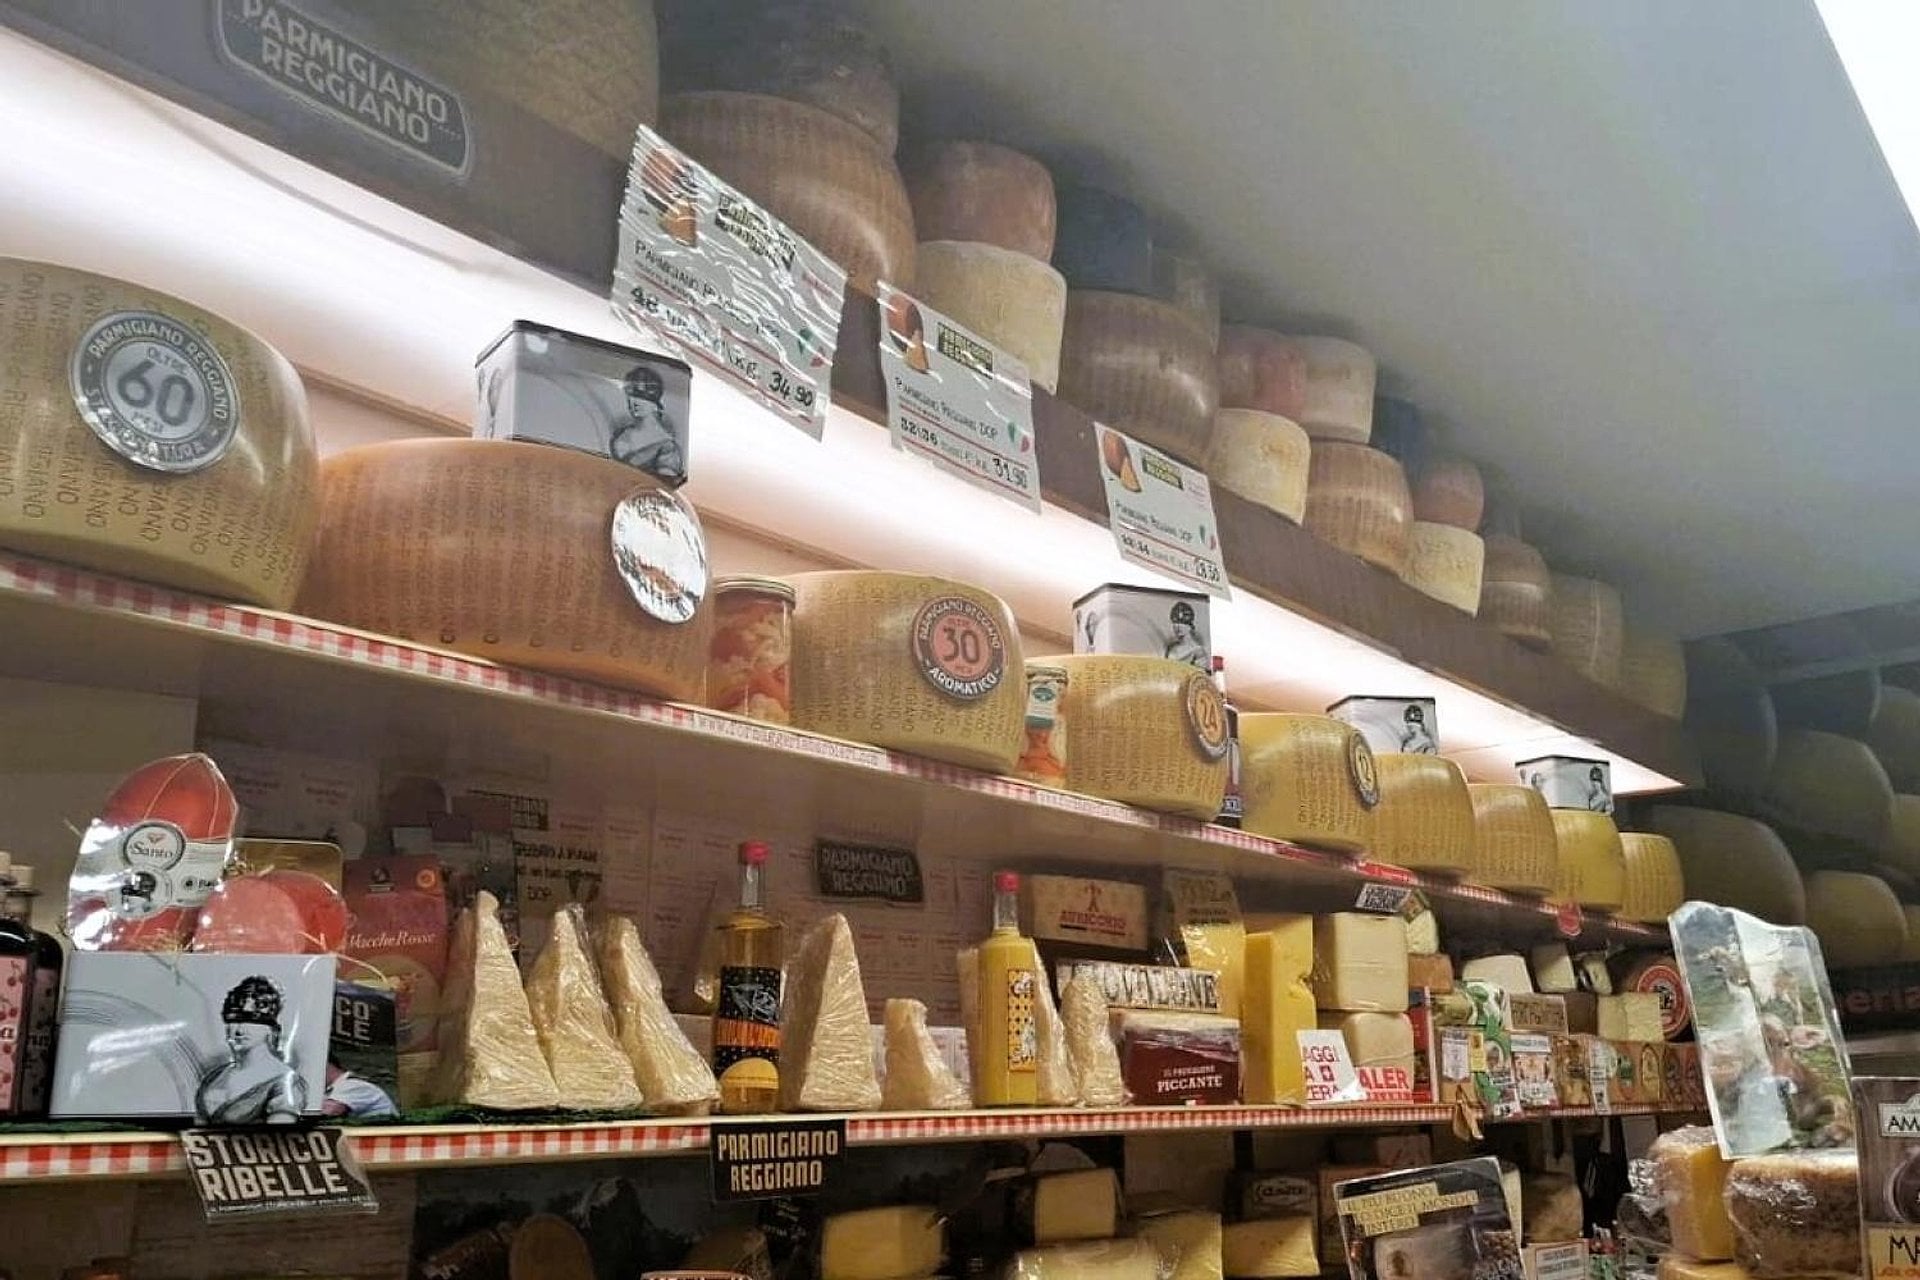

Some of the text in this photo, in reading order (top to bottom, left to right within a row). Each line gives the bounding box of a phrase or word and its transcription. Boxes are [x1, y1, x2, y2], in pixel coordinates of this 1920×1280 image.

[261, 36, 429, 143] REGGIANO
[89, 319, 229, 420] PARMIGIANO REGGIANO
[117, 360, 195, 427] 60
[943, 628, 980, 665] 30
[928, 666, 998, 695] AROMATICO
[1157, 1075, 1224, 1093] PICCANTE
[185, 1131, 333, 1168] STORICO
[717, 1129, 840, 1160] PARMIGIANO
[197, 1161, 348, 1201] RIBELLE
[730, 1159, 823, 1193] REGGIANO
